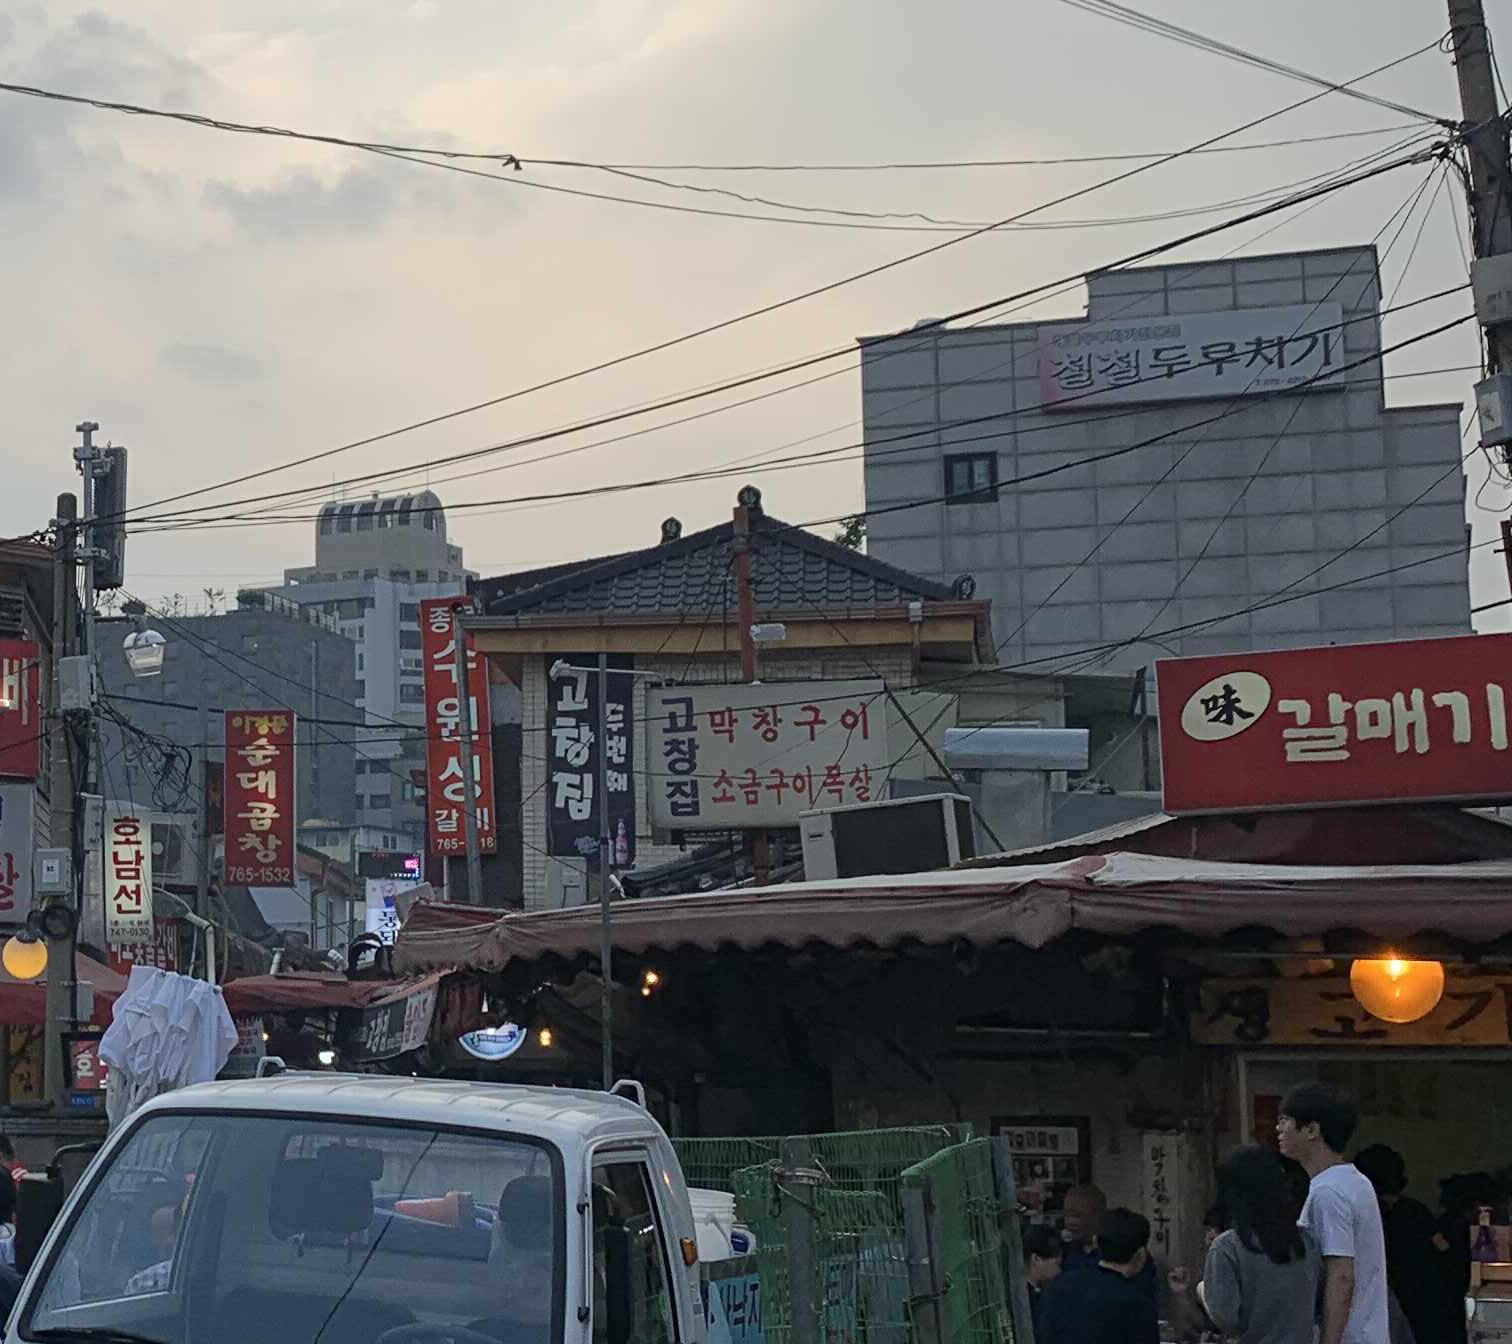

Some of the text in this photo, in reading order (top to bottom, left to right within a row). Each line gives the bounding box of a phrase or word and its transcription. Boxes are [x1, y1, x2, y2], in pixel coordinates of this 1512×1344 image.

[550, 666, 595, 821] 고창집
[661, 696, 700, 817] 고창집
[707, 702, 869, 743] 막창구이
[236, 736, 282, 864] 순대곱창
[112, 815, 144, 915] 호남선
[229, 866, 291, 883] 765-1532
